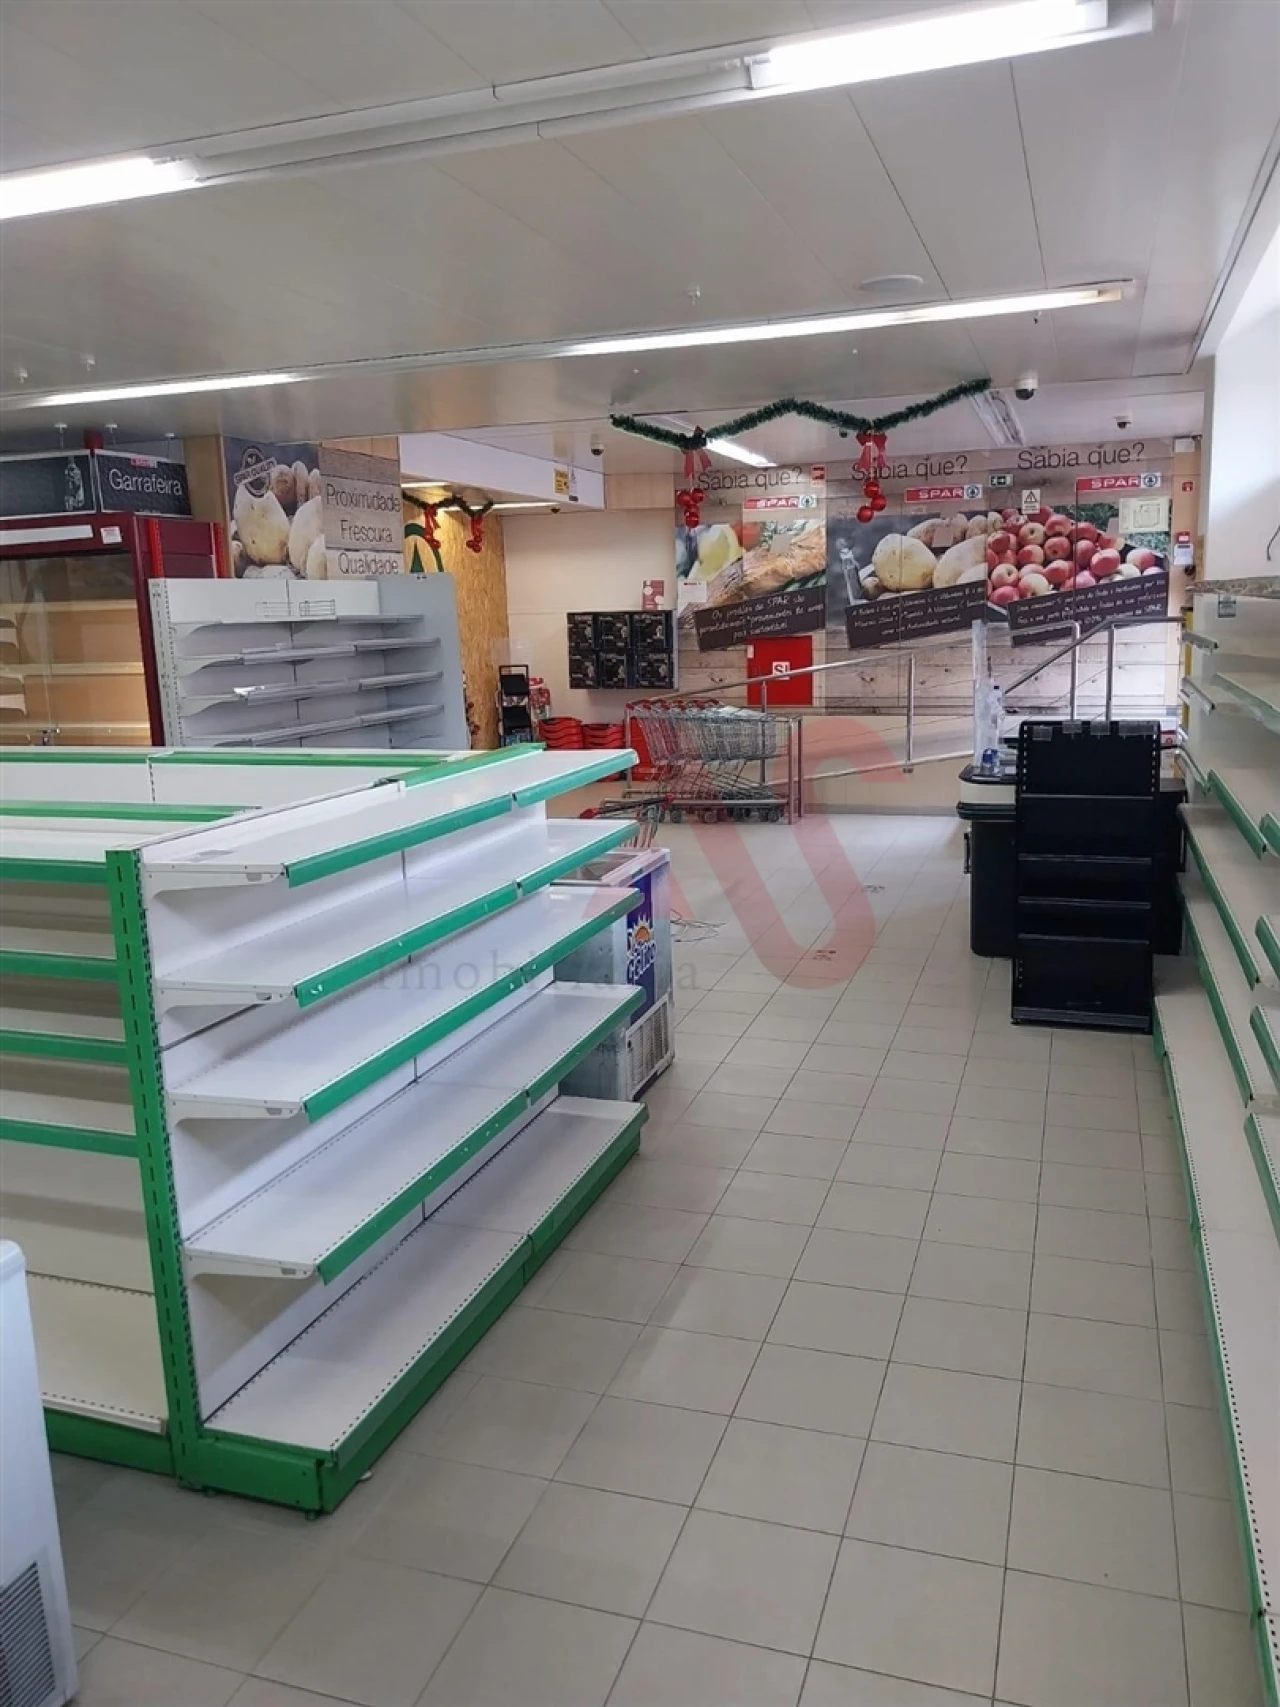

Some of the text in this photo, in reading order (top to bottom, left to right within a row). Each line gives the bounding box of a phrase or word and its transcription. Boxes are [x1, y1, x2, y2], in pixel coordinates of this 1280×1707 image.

[916, 455, 968, 481] que?
[1017, 442, 1145, 470] Sabia que?
[109, 468, 183, 496] Garrafeira
[698, 466, 802, 491] Sabia que?
[1091, 479, 1140, 489] SPAR
[326, 483, 401, 513] Proximidade
[756, 497, 799, 508] SPAR
[918, 489, 964, 499] SPAR
[340, 520, 393, 543] Frescura
[338, 552, 399, 575] Qualidade
